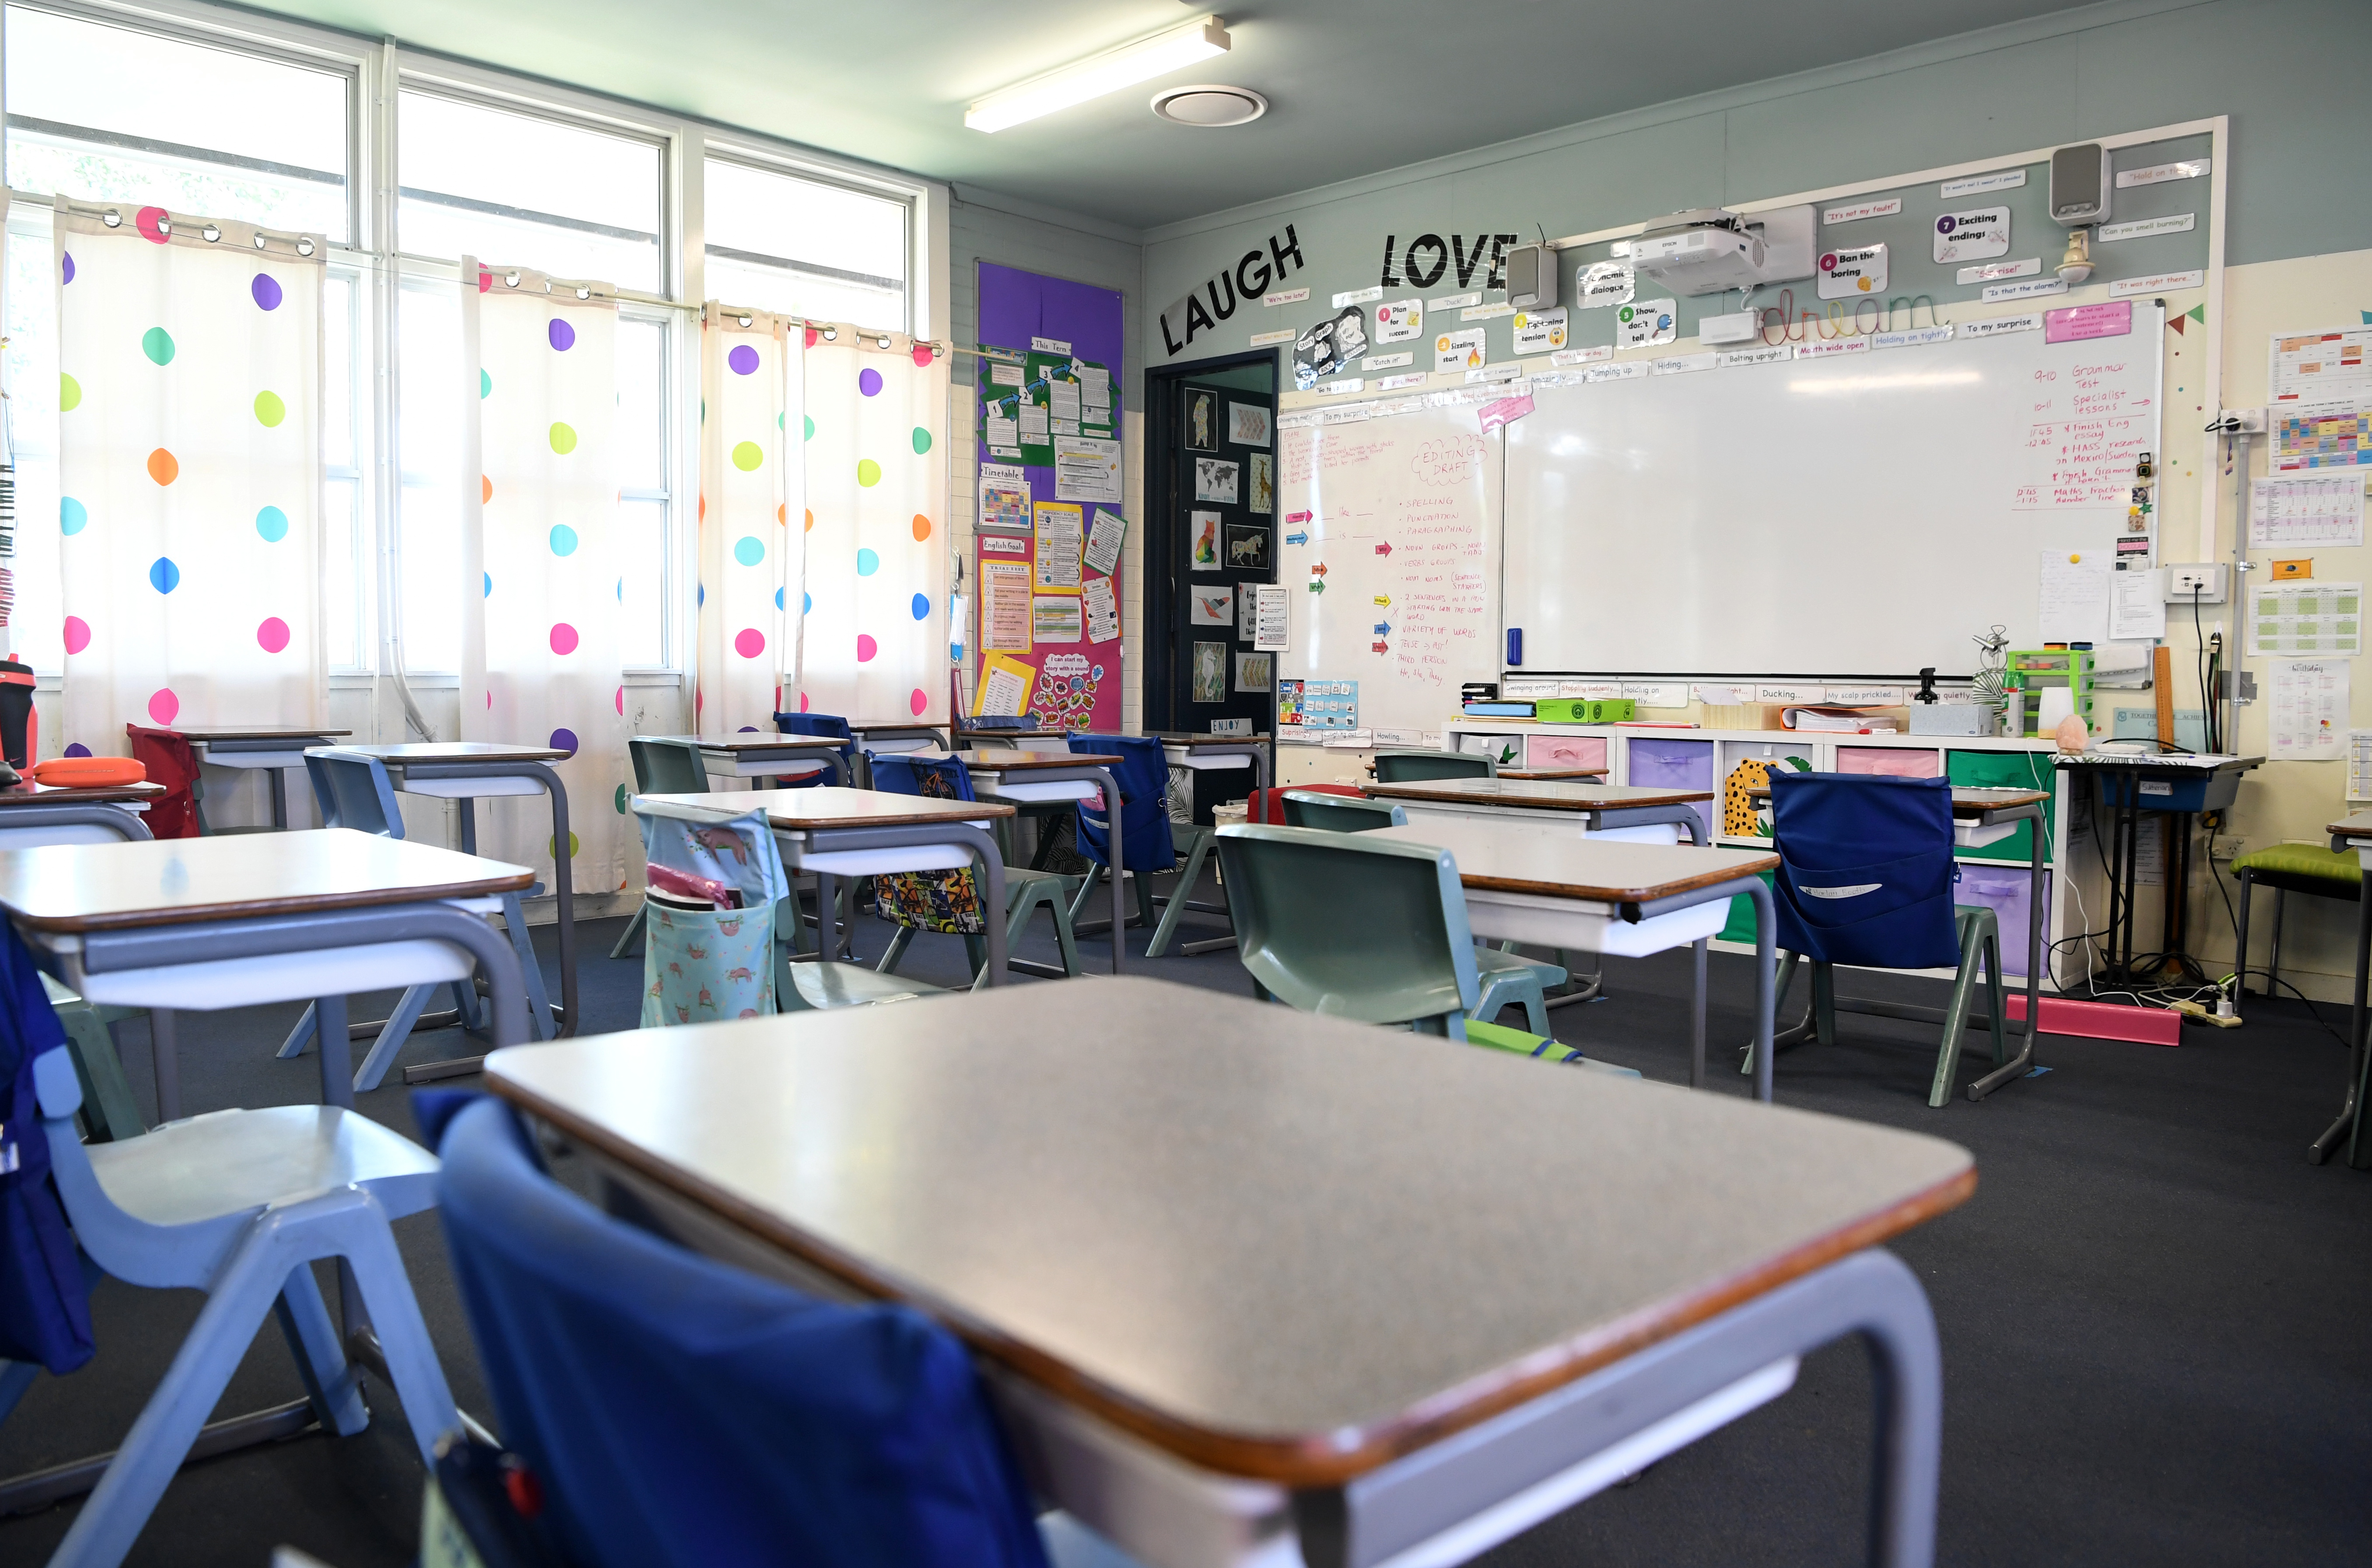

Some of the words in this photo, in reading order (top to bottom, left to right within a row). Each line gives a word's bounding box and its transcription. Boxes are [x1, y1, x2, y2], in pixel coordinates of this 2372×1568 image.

[1860, 208, 1869, 217] my
[1958, 213, 1997, 226] Exciting
[1943, 221, 1950, 230] 7
[2120, 226, 2134, 234] you
[1948, 230, 1986, 242] endings
[1381, 233, 1519, 289] LOVE
[1839, 254, 1858, 264] Ban
[1860, 251, 1875, 260] the
[1831, 268, 1861, 279] boring
[2145, 278, 2163, 287] right
[1160, 223, 1305, 357] LAUGH
[1591, 285, 1623, 294] dialogue
[1636, 307, 1657, 316] Show,
[1628, 321, 1648, 329] don't
[1981, 323, 1994, 333] my
[1997, 318, 2031, 330] surprise
[1316, 325, 1332, 339] Graph
[1632, 334, 1644, 342] tell
[1876, 335, 1905, 345] Holding
[1035, 340, 1048, 350] This
[1299, 338, 1314, 350] Story
[1451, 341, 1475, 350] Sizzling
[1826, 343, 1843, 352] wide
[1847, 341, 1864, 352] open
[1730, 353, 1753, 363] Bolting
[1756, 352, 1782, 362] upright
[1321, 362, 1334, 373] ROCK
[1658, 361, 1689, 371] Hiding...
[1591, 367, 1620, 378] Jumping
[1624, 367, 1632, 376] up
[2035, 370, 2056, 383] 9-10
[2072, 363, 2127, 377] Grammar
[2076, 379, 2099, 389] Test
[2035, 399, 2052, 411] 10-11
[2073, 389, 2126, 406] Specialist
[2076, 404, 2117, 414] lessons
[2075, 430, 2104, 440] essay
[2072, 443, 2100, 453] HASS
[1423, 446, 1475, 463] EDITING
[983, 467, 1019, 479] Timetable
[1434, 462, 1468, 475] DRAFT
[2055, 488, 2082, 496] Maths
[1406, 497, 1453, 508] SPELLING
[1339, 506, 1351, 517] like
[1407, 525, 1472, 535] PARAGRAPHING
[1339, 531, 1346, 540] is
[984, 540, 1006, 550] English
[1402, 625, 1434, 635] VARIETY
[1454, 629, 1476, 638] WORDS
[1400, 639, 1420, 649] TENSE
[1397, 654, 1415, 664] THIRD
[1422, 656, 1447, 664] PERSON
[2292, 664, 2323, 673] birthday
[1506, 684, 1532, 693] Swinging
[1561, 685, 1586, 693] Stopping
[1624, 686, 1648, 695] Holding
[1762, 689, 1803, 700] Ducking...
[1828, 692, 1838, 700] My
[1841, 691, 1859, 700] scalp
[1213, 720, 1240, 732] ENJOY
[1282, 729, 1317, 738] Suprisingly...
[1377, 732, 1405, 742] Howling...
[941, 769, 959, 779] BMX
